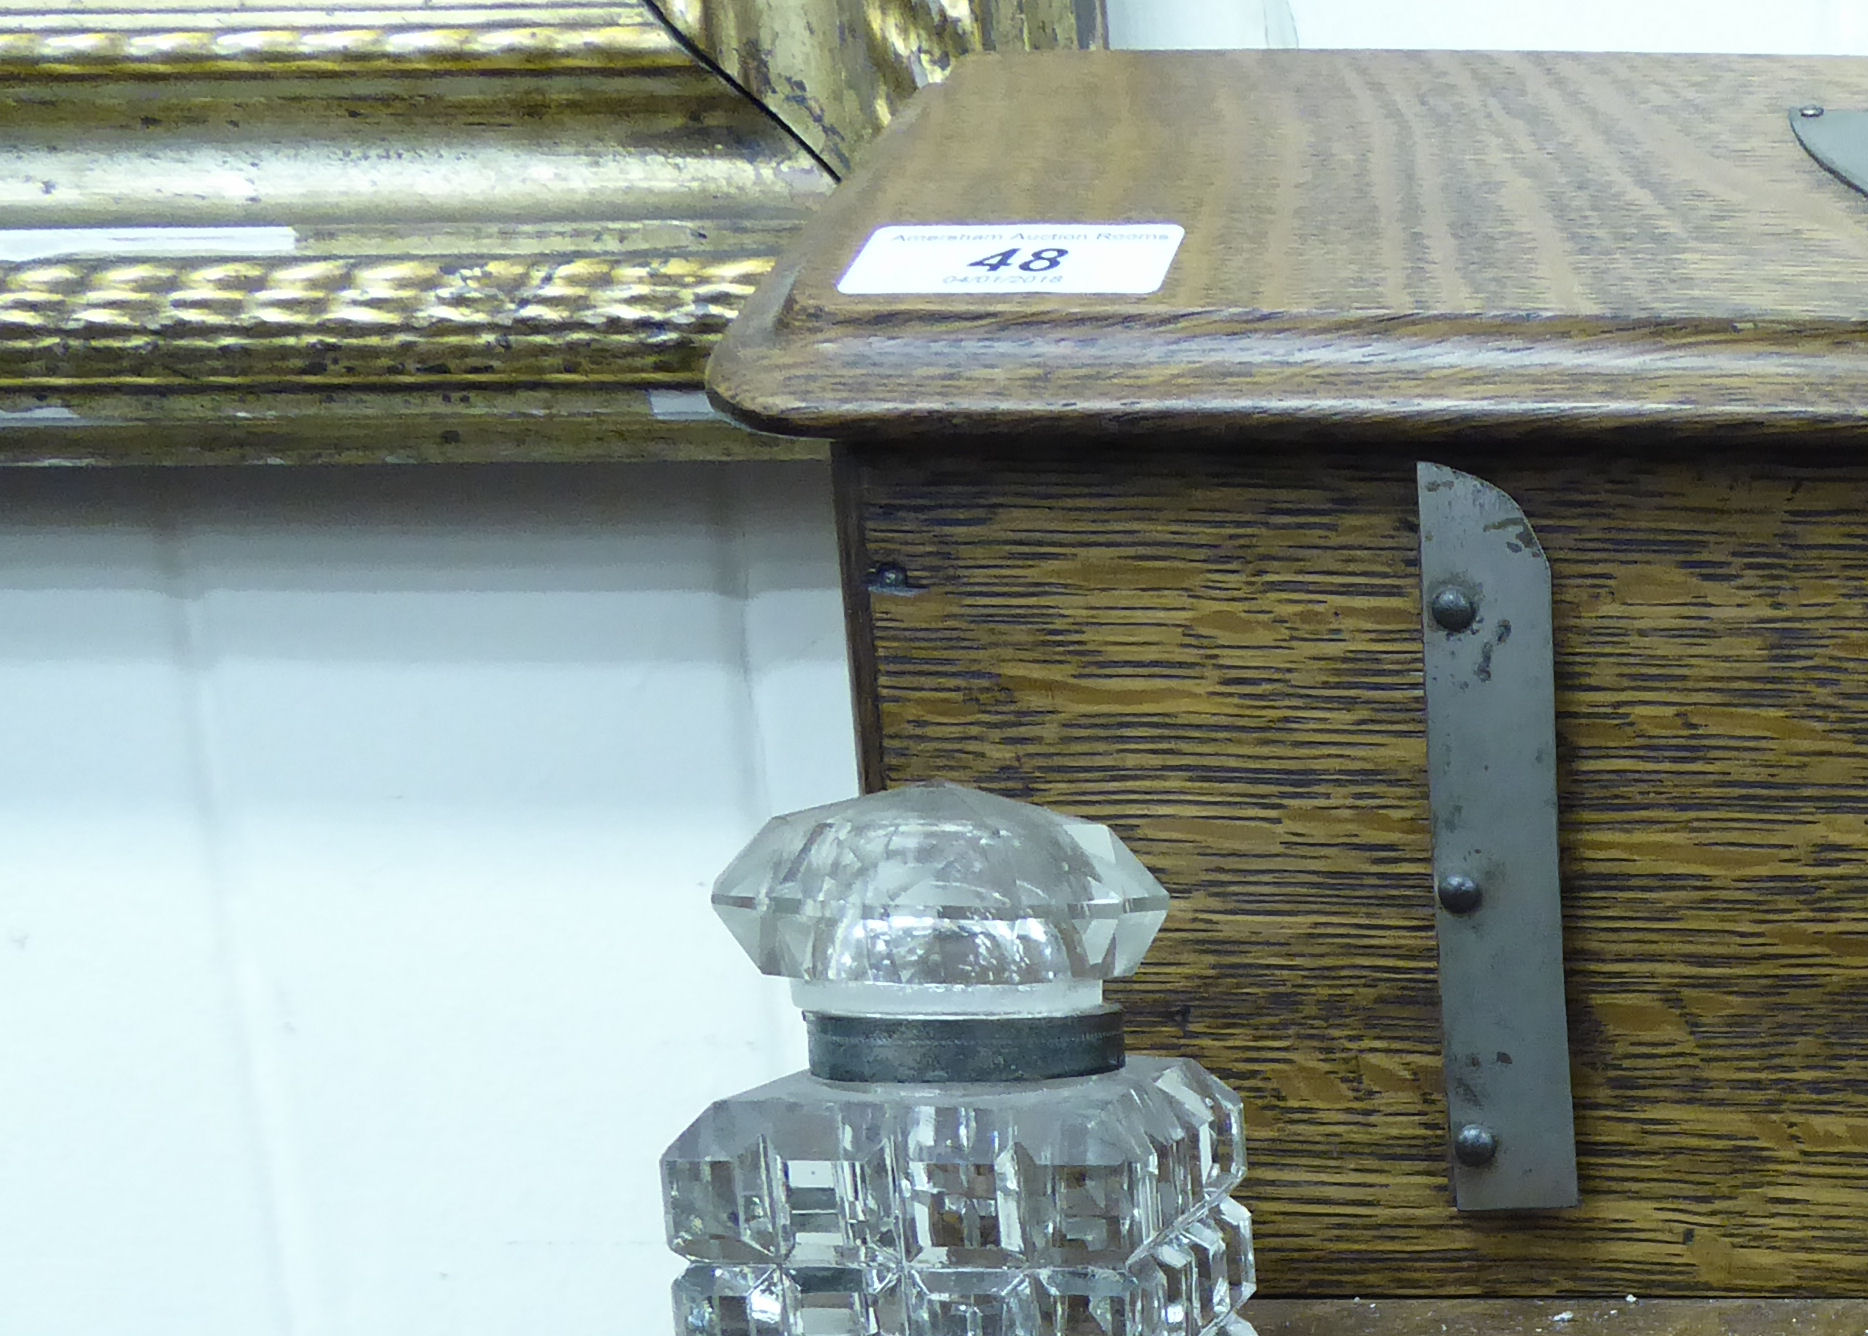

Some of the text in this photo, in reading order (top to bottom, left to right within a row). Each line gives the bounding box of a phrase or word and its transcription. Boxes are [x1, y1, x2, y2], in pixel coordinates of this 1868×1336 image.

[892, 231, 1169, 242] Amersham Auction Rooms
[967, 247, 1069, 272] 48
